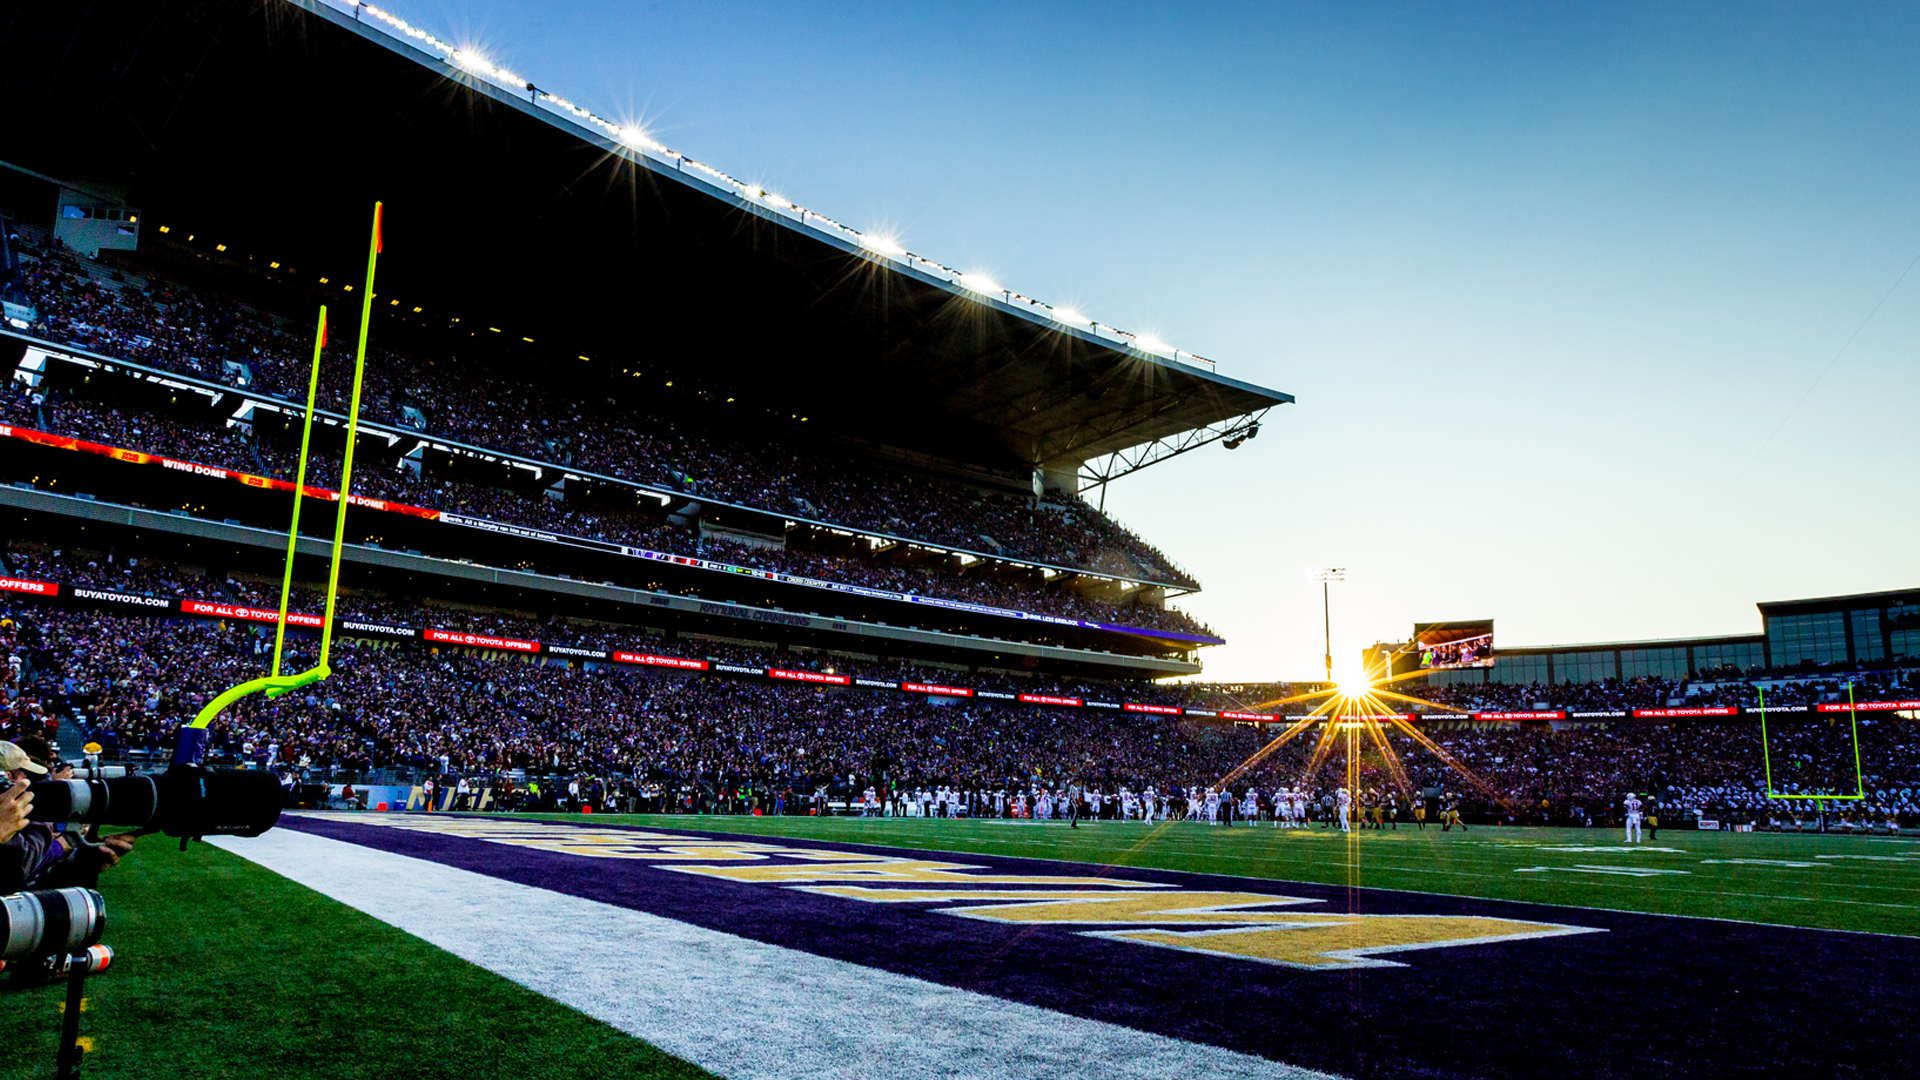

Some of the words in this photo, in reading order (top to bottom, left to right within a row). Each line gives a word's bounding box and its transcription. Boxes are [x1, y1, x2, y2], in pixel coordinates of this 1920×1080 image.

[163, 459, 193, 473] WING
[195, 466, 227, 479] DOME
[331, 492, 356, 504] WG
[357, 498, 384, 509] DOME
[0, 579, 44, 592] OFFERS
[74, 588, 169, 608] BUYATOYOTA.COM
[194, 604, 213, 613] FOR
[216, 607, 233, 615] ALL
[287, 615, 321, 625] OFFERS
[753, 610, 810, 626] CHAMPIONS
[343, 621, 415, 636] BUYATOYOTA.COM
[433, 632, 448, 640] FOR
[450, 634, 463, 642] ALL
[476, 637, 503, 647] TOYOTA
[505, 641, 531, 650] OFFERS
[549, 646, 606, 659] BUYATOYOTA.COM
[656, 658, 678, 666] TOYOTA
[679, 661, 701, 669] OFFERS
[715, 664, 763, 675] BUYATOYOTA.COM
[1631, 802, 1639, 811] 11
